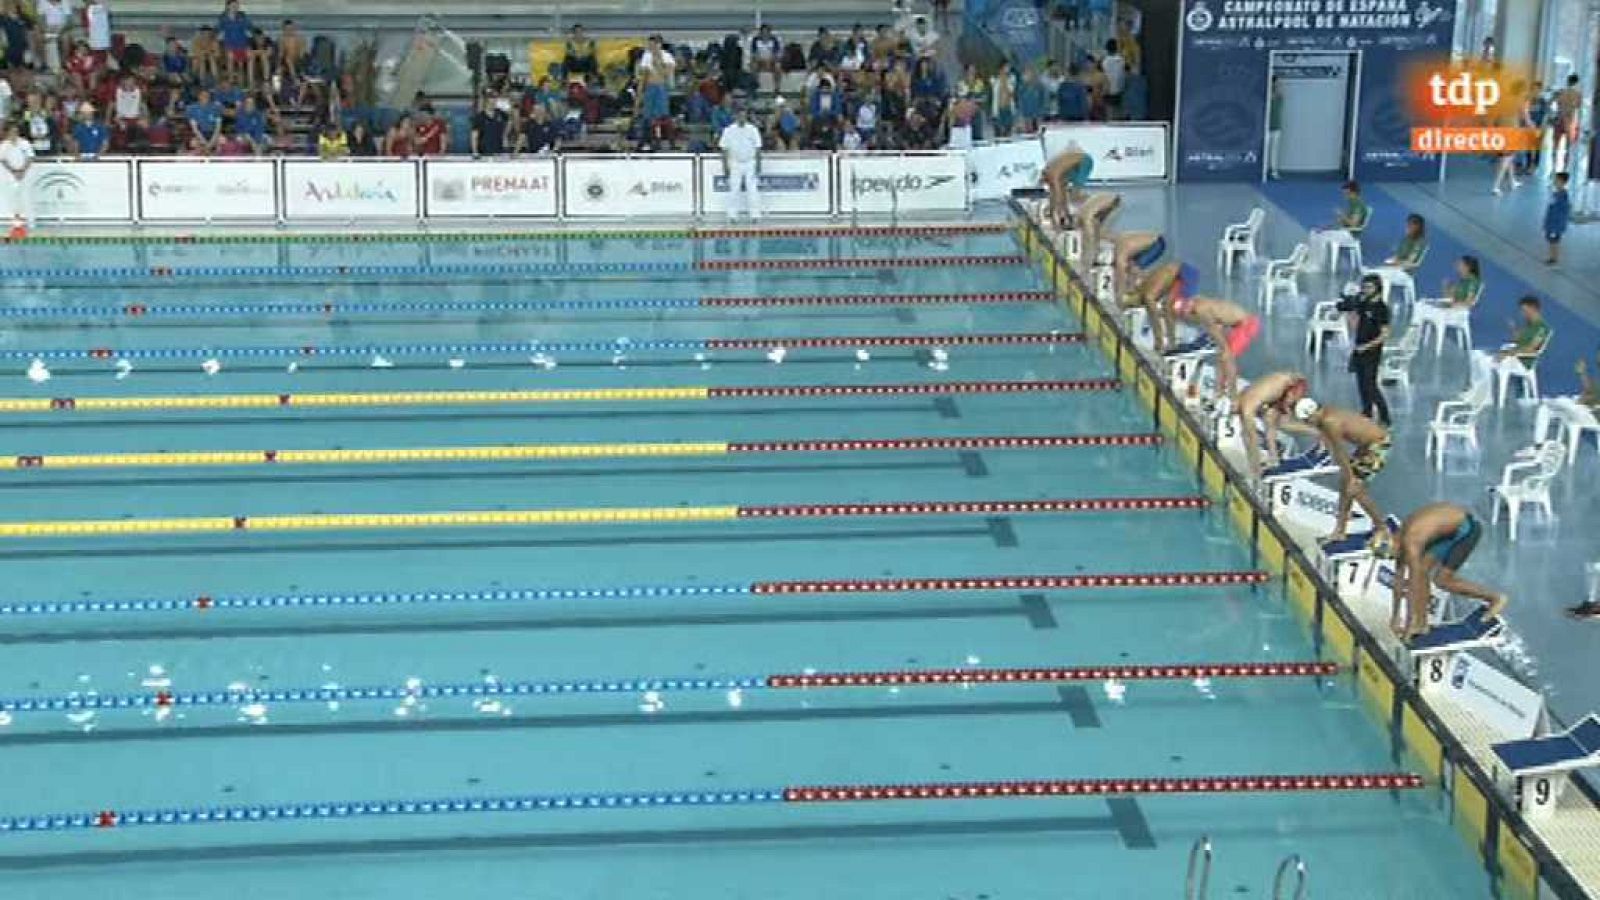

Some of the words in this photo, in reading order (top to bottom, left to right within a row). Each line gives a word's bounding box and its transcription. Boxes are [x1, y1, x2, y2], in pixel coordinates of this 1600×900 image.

[1224, 0, 1320, 12] CAMPEONATO
[1325, 0, 1343, 12] DE
[1218, 14, 1311, 28] ASTRALPOOL
[1316, 14, 1334, 27] DE
[471, 176, 549, 193] PREMAAT
[1102, 275, 1111, 289] 2
[1224, 419, 1235, 438] 5
[1281, 485, 1291, 506] 6
[1349, 562, 1359, 584] 7
[1430, 658, 1443, 683] 8
[1535, 778, 1549, 805] 9
